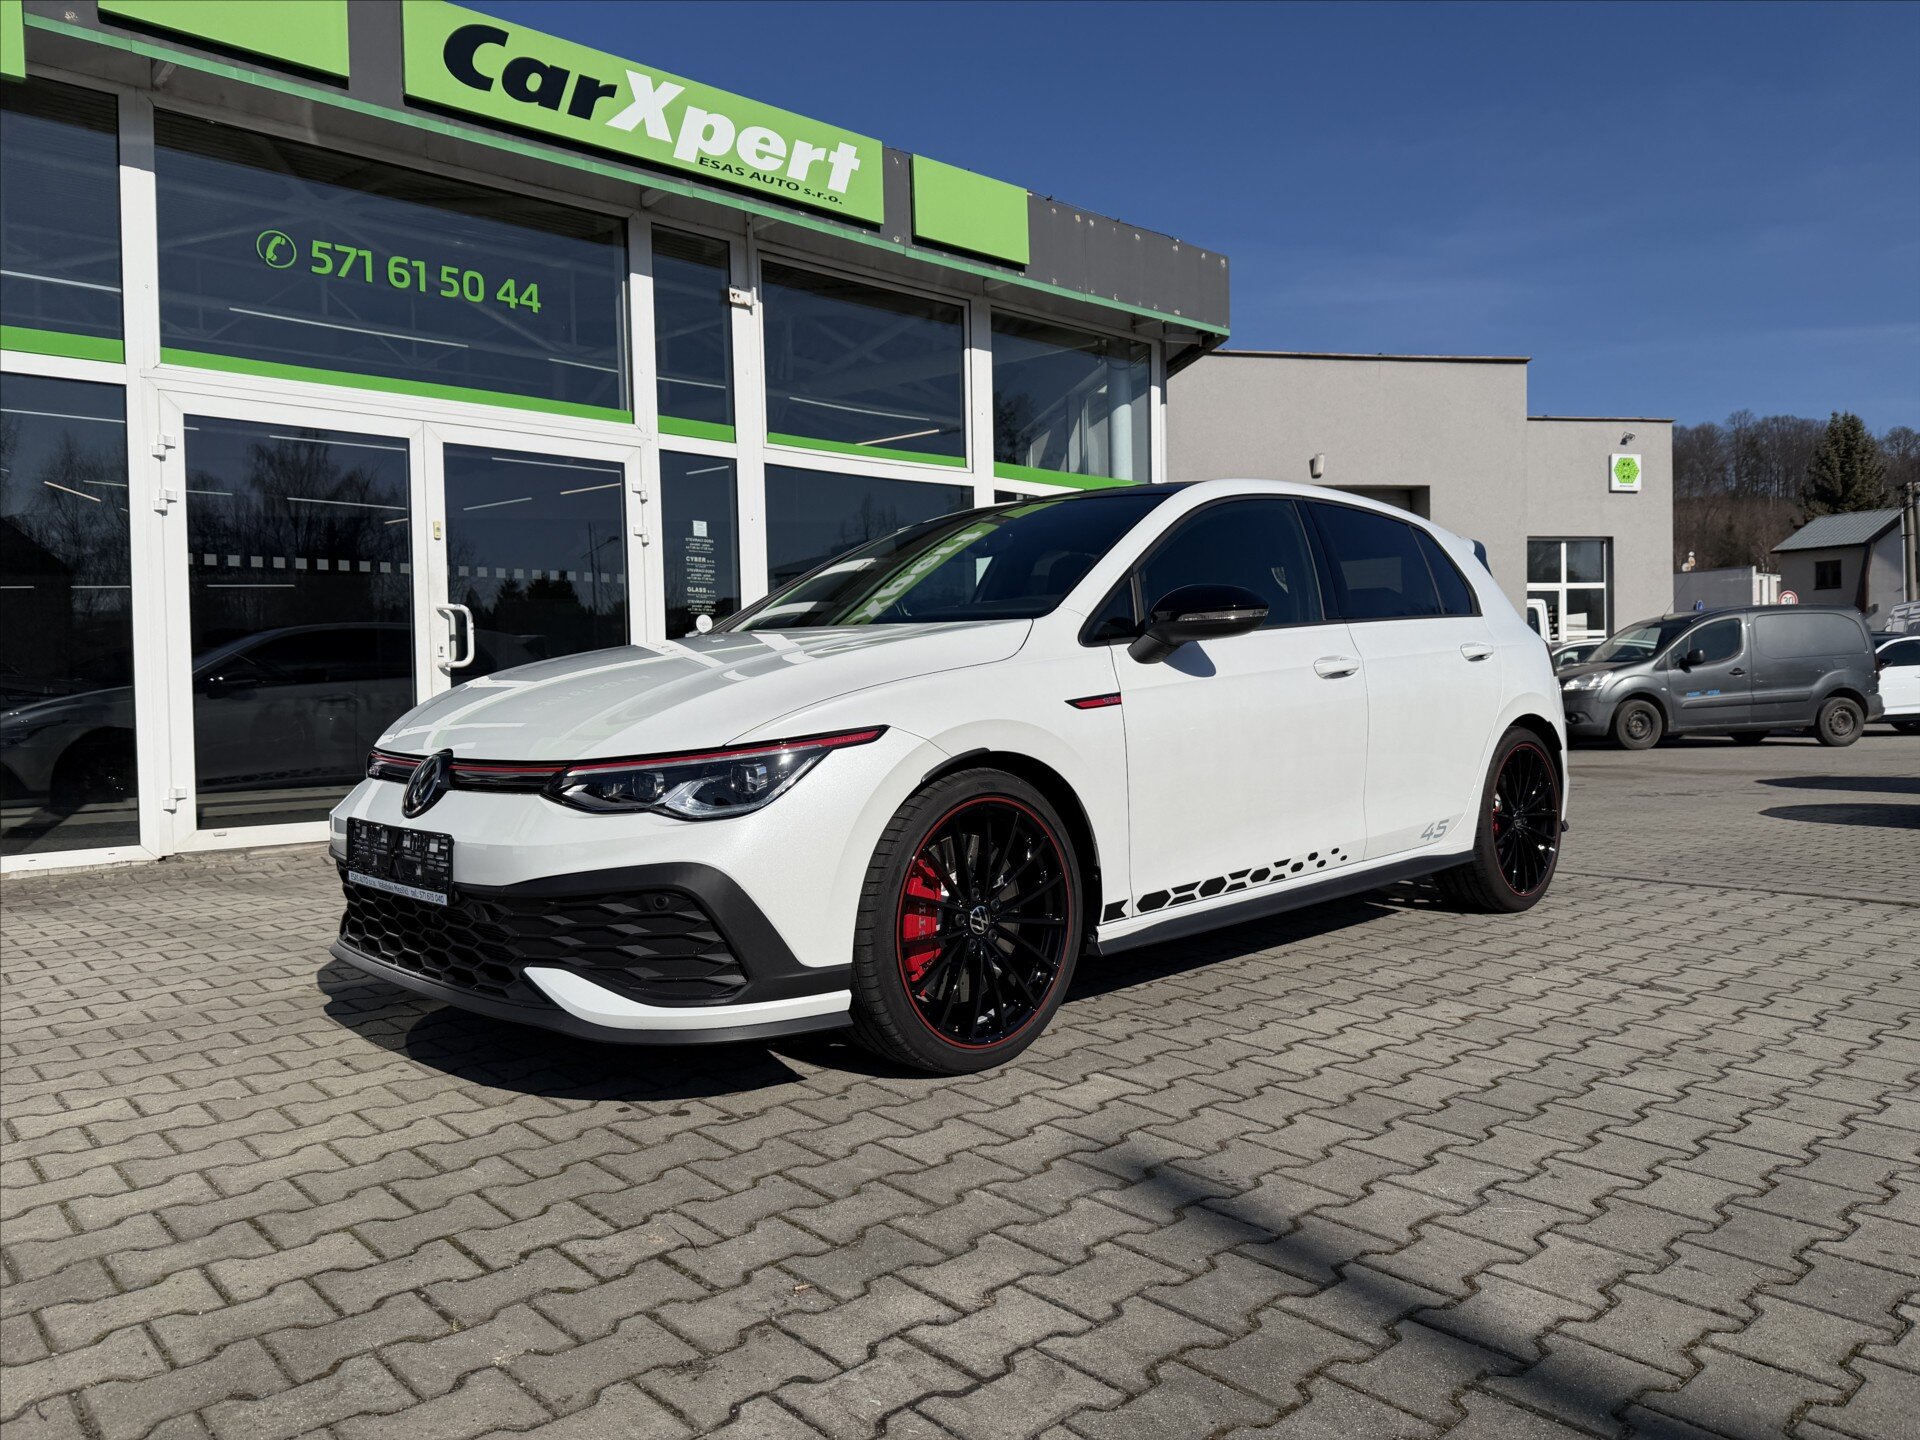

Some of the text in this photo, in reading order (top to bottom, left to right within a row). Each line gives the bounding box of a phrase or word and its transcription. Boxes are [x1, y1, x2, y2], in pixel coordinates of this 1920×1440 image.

[443, 23, 861, 194] CarXpert
[698, 156, 843, 205] ESAS AUTO s.r.o.
[311, 239, 541, 314] 571 61 50 44
[685, 555, 706, 563] CYBER
[1783, 596, 1793, 605] 30
[1420, 818, 1449, 841] 45
[350, 872, 359, 881] ESAS
[359, 875, 369, 885] AUTO
